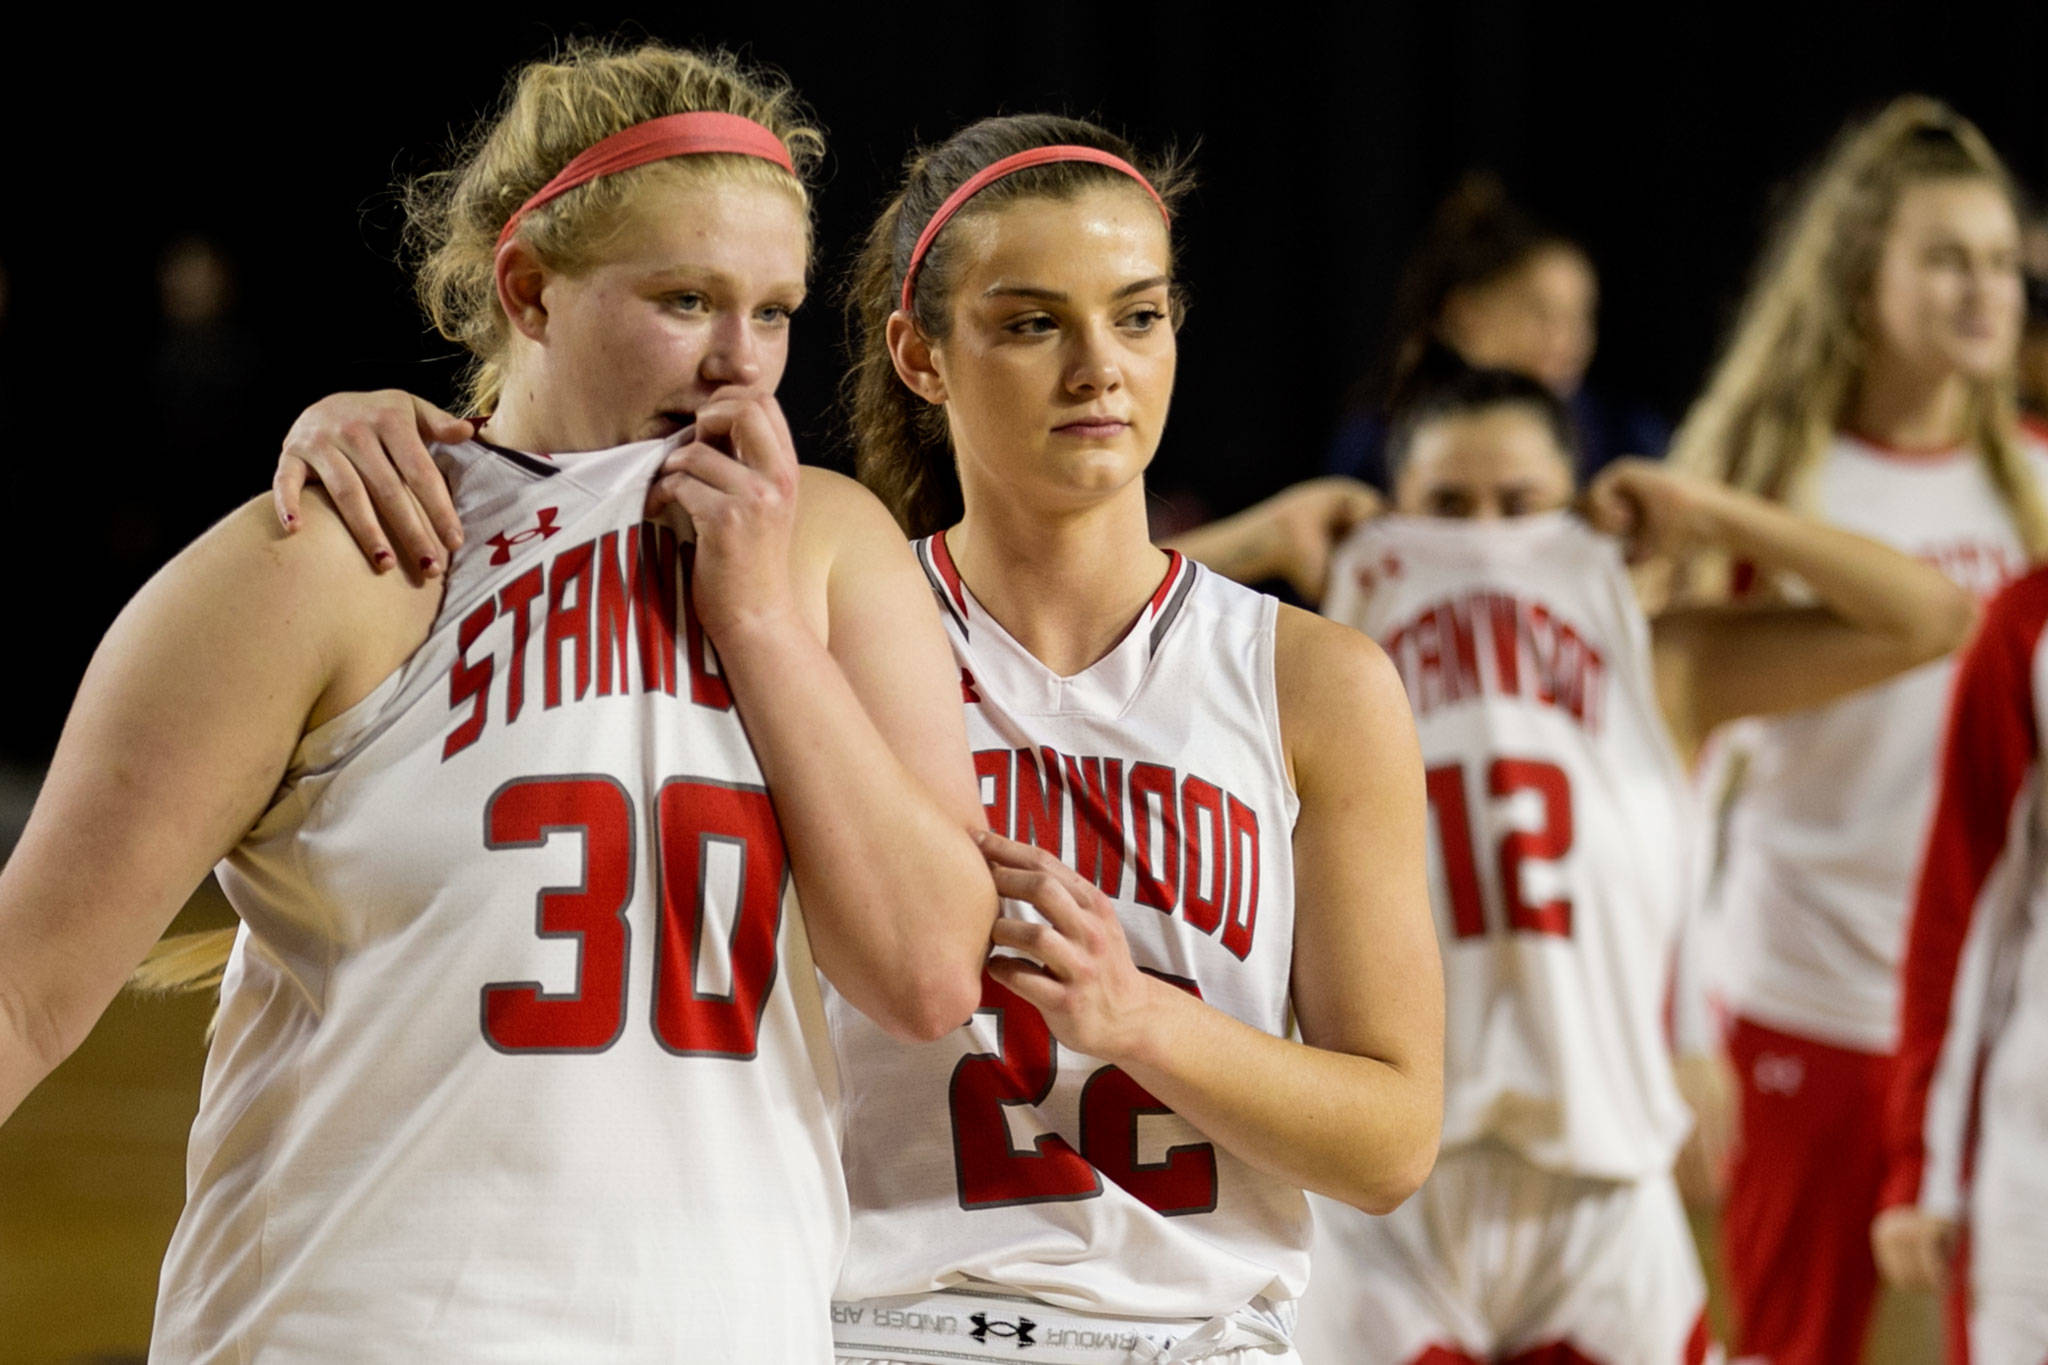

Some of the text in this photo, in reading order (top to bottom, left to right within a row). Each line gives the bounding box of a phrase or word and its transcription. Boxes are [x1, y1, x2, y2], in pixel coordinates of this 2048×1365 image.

[480, 773, 790, 1061] 30
[1425, 756, 1577, 941] 12
[873, 1308, 957, 1336] UNDER
